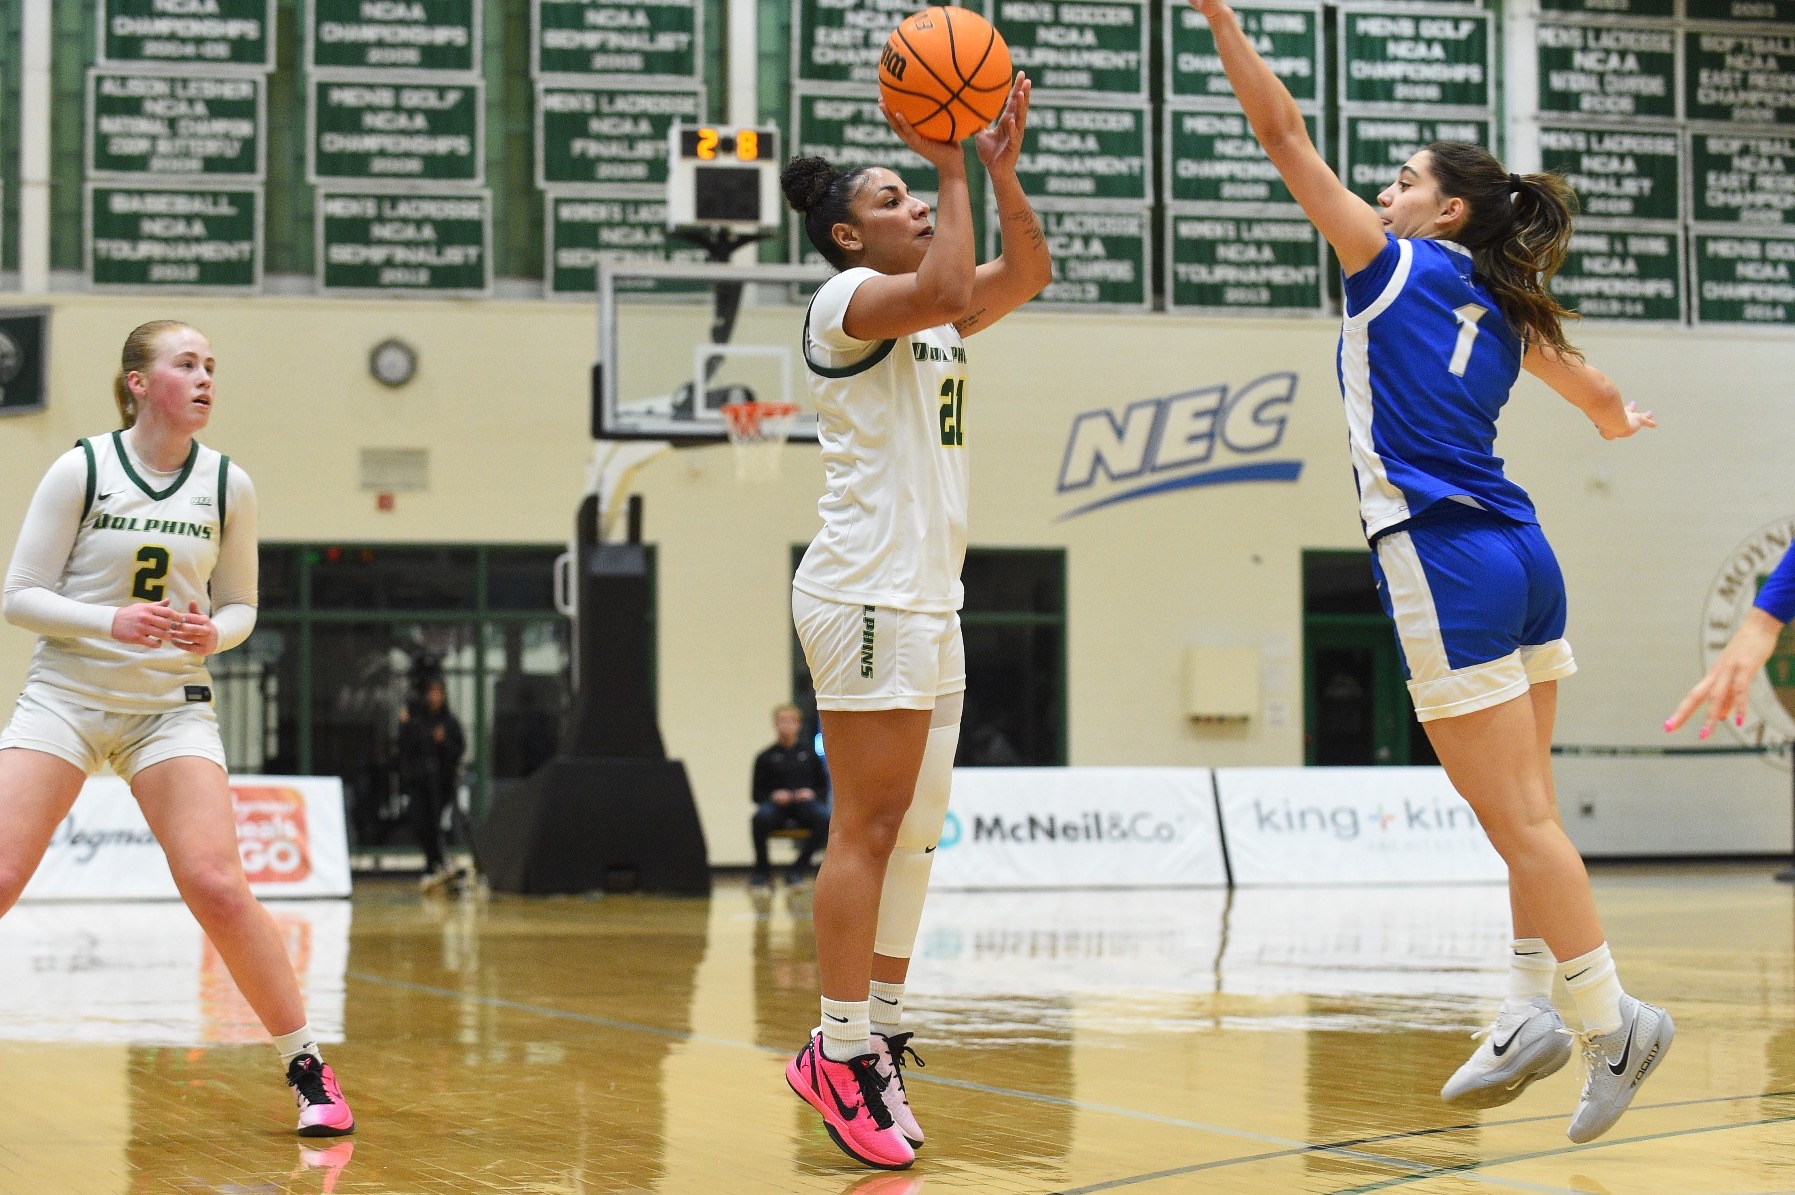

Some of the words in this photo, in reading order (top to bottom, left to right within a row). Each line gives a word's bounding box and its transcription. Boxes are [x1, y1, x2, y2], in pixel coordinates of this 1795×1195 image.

[359, 2, 426, 21] NCAA
[585, 8, 650, 27] NCAA
[320, 22, 468, 46] CHAMPIONSHIPS
[1036, 26, 1097, 46] NCAA
[1386, 40, 1446, 60] NCAA
[1573, 51, 1639, 72] NCAA
[1725, 53, 1779, 71] NCAA
[143, 99, 208, 118] NCAA
[362, 110, 428, 131] NCAA
[588, 117, 653, 136] NCAA
[320, 133, 471, 157] CHAMPIONSHIPS
[1038, 132, 1100, 152] NCAA
[1581, 155, 1637, 174] NCAA
[1731, 156, 1786, 175] NCAA
[109, 193, 239, 216] BASEBALL
[140, 217, 207, 238] NCAA
[370, 221, 436, 242] NCAA
[95, 239, 252, 262] TOURNAMENT
[1216, 242, 1275, 262] NCAA
[1175, 264, 1318, 285] TOURNAMENT
[1582, 255, 1638, 274] NCAA
[1735, 261, 1790, 280] NCAA
[1448, 303, 1489, 378] 1
[938, 376, 966, 448] 21
[1057, 371, 1298, 493] NEC
[92, 513, 213, 540] DOLPHINS
[131, 544, 173, 603] 2
[1253, 797, 1360, 842] king
[1404, 797, 1478, 829] kin
